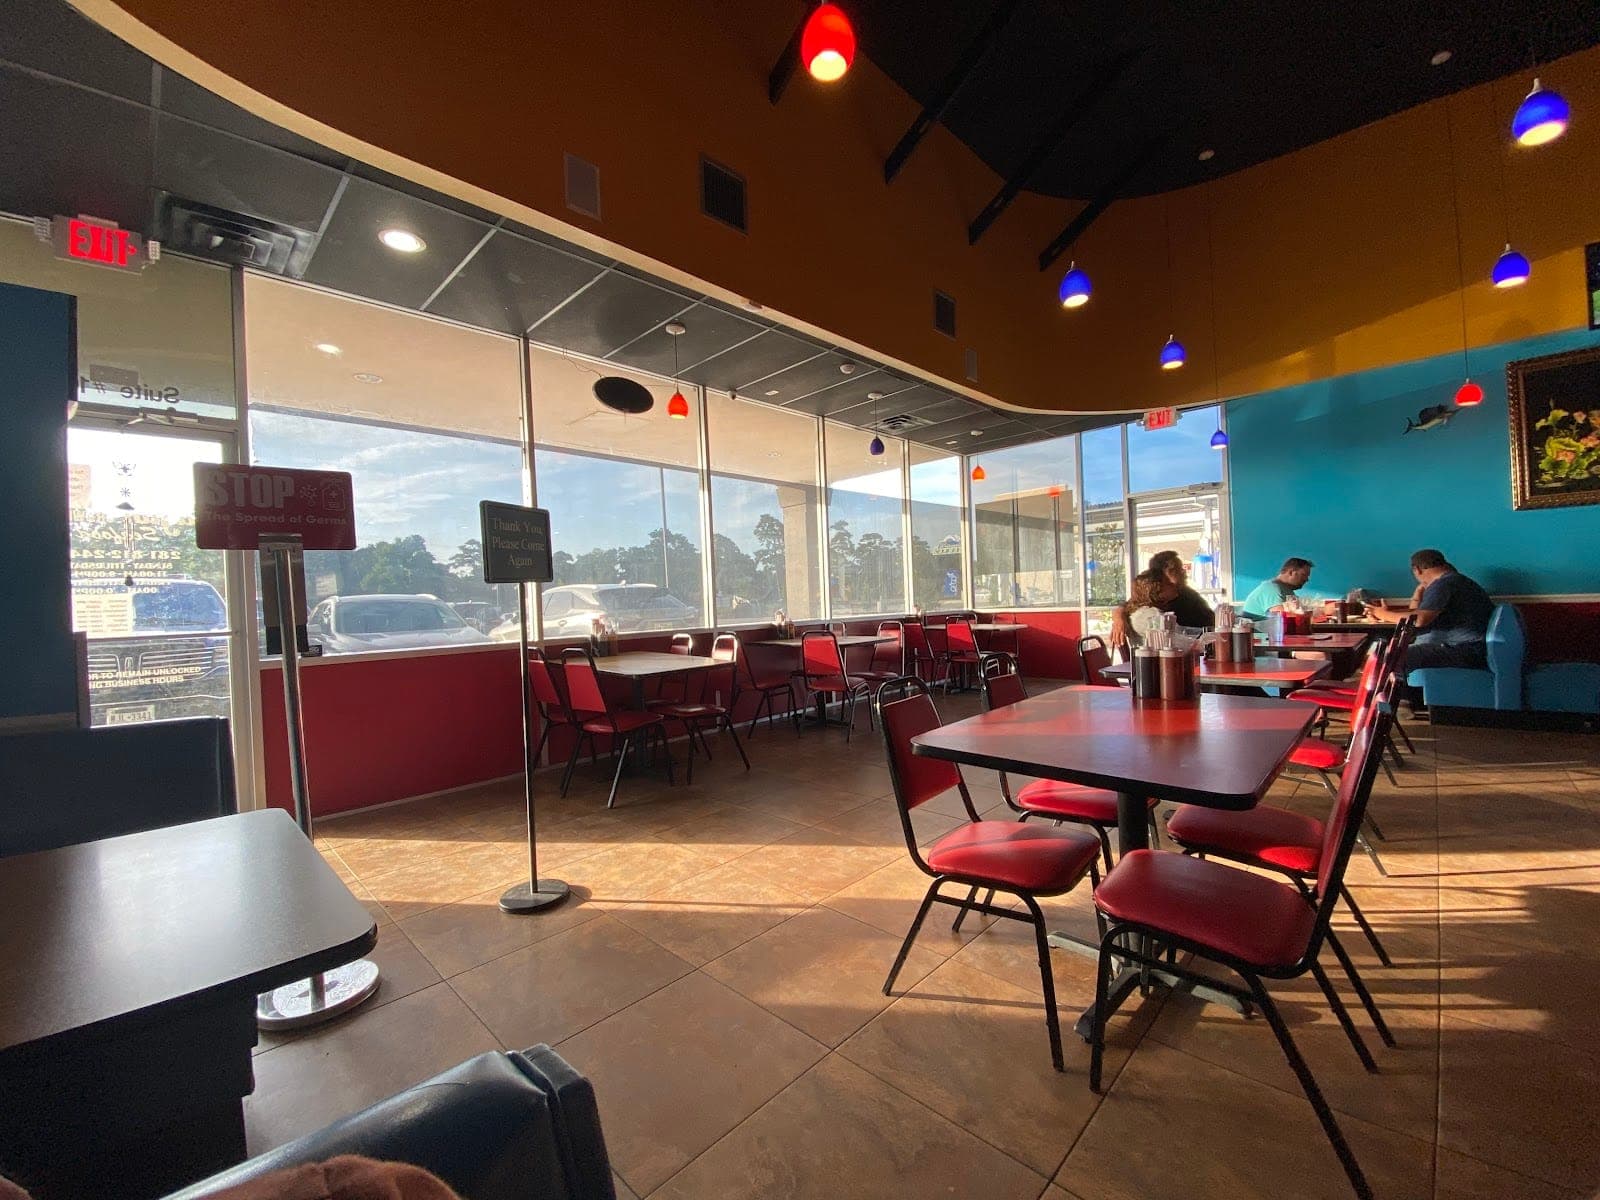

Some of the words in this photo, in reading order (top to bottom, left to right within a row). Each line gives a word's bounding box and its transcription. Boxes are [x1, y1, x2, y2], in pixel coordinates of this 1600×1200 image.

[69, 219, 129, 267] EXIT
[1147, 407, 1174, 429] EXIT
[204, 470, 295, 509] STOP
[206, 511, 231, 521] The
[235, 512, 285, 526] Spread
[289, 514, 302, 524] of
[306, 514, 346, 526] Germs
[488, 517, 520, 533] Thank
[523, 520, 543, 534] You
[492, 536, 519, 550] Please
[521, 538, 545, 551] Come
[507, 554, 533, 568] Again
[115, 669, 152, 679] REMAIN
[153, 667, 201, 676] UNLOCKED
[104, 678, 151, 688] BUSINESS
[152, 675, 184, 685] HOURS
